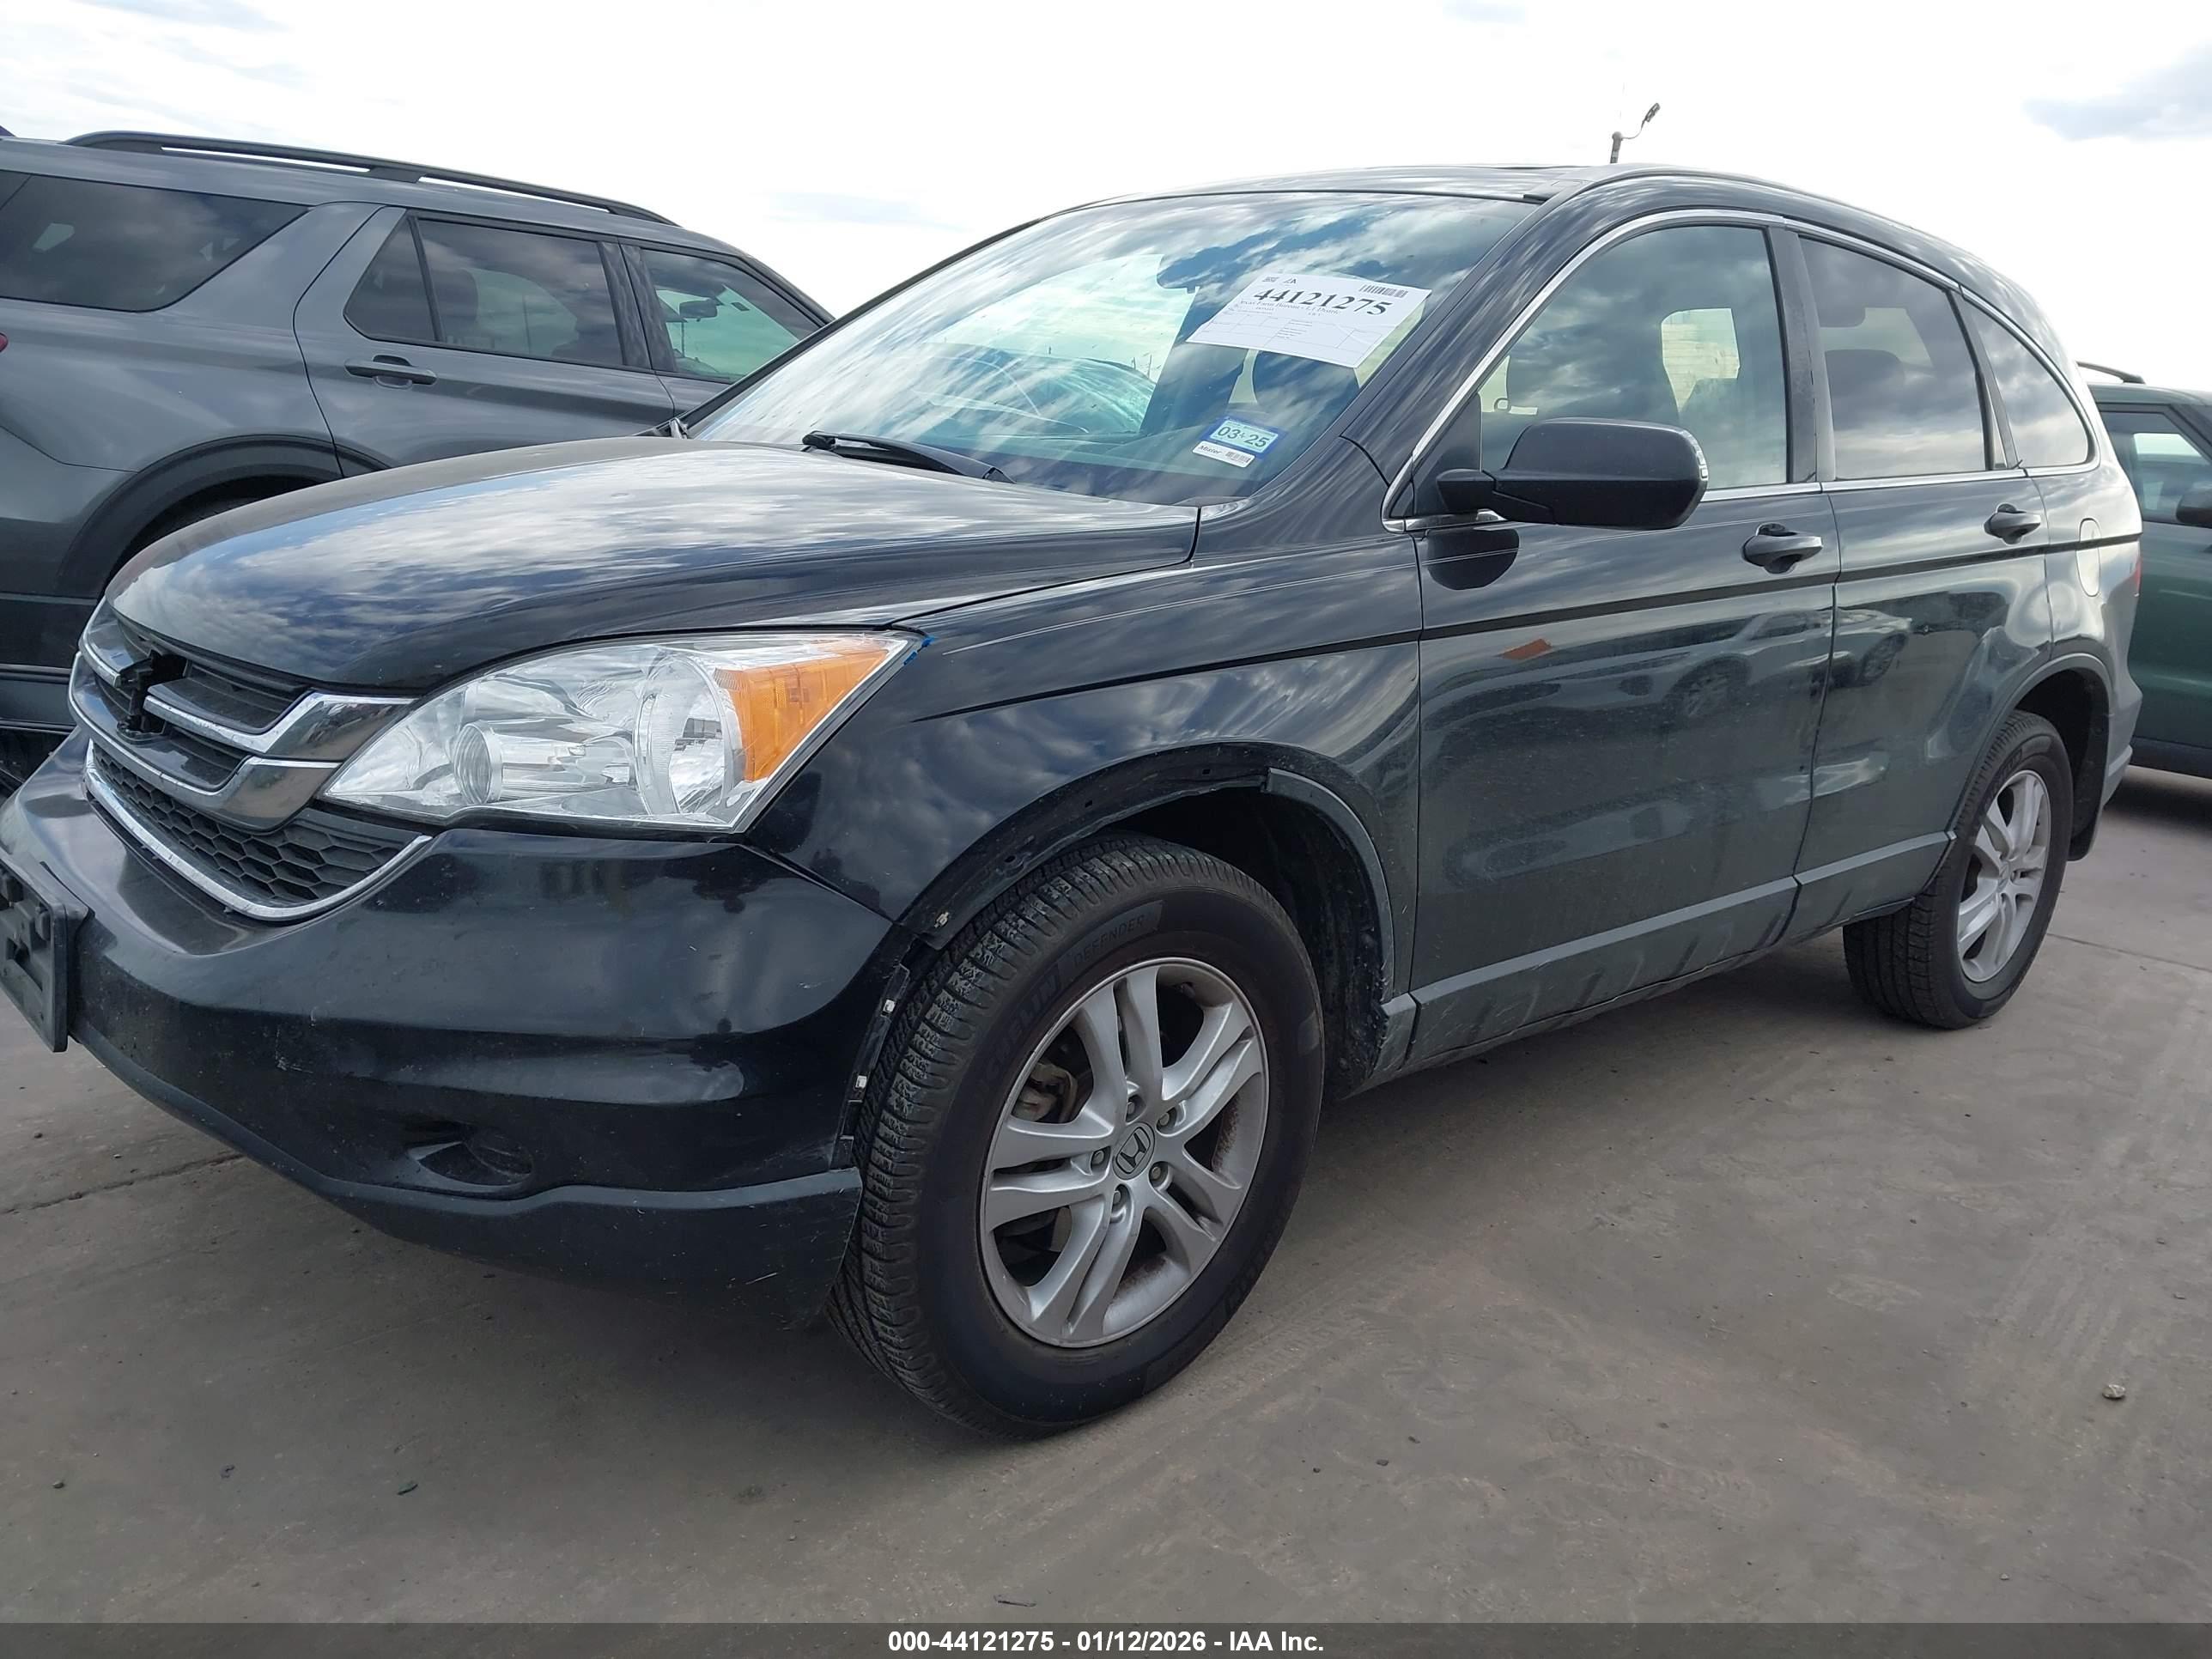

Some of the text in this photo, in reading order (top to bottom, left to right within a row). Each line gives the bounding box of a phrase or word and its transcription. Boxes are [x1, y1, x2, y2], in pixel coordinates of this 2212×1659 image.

[1254, 288, 1393, 315] 44121275
[1218, 426, 1240, 439] 03
[1243, 434, 1270, 447] 25
